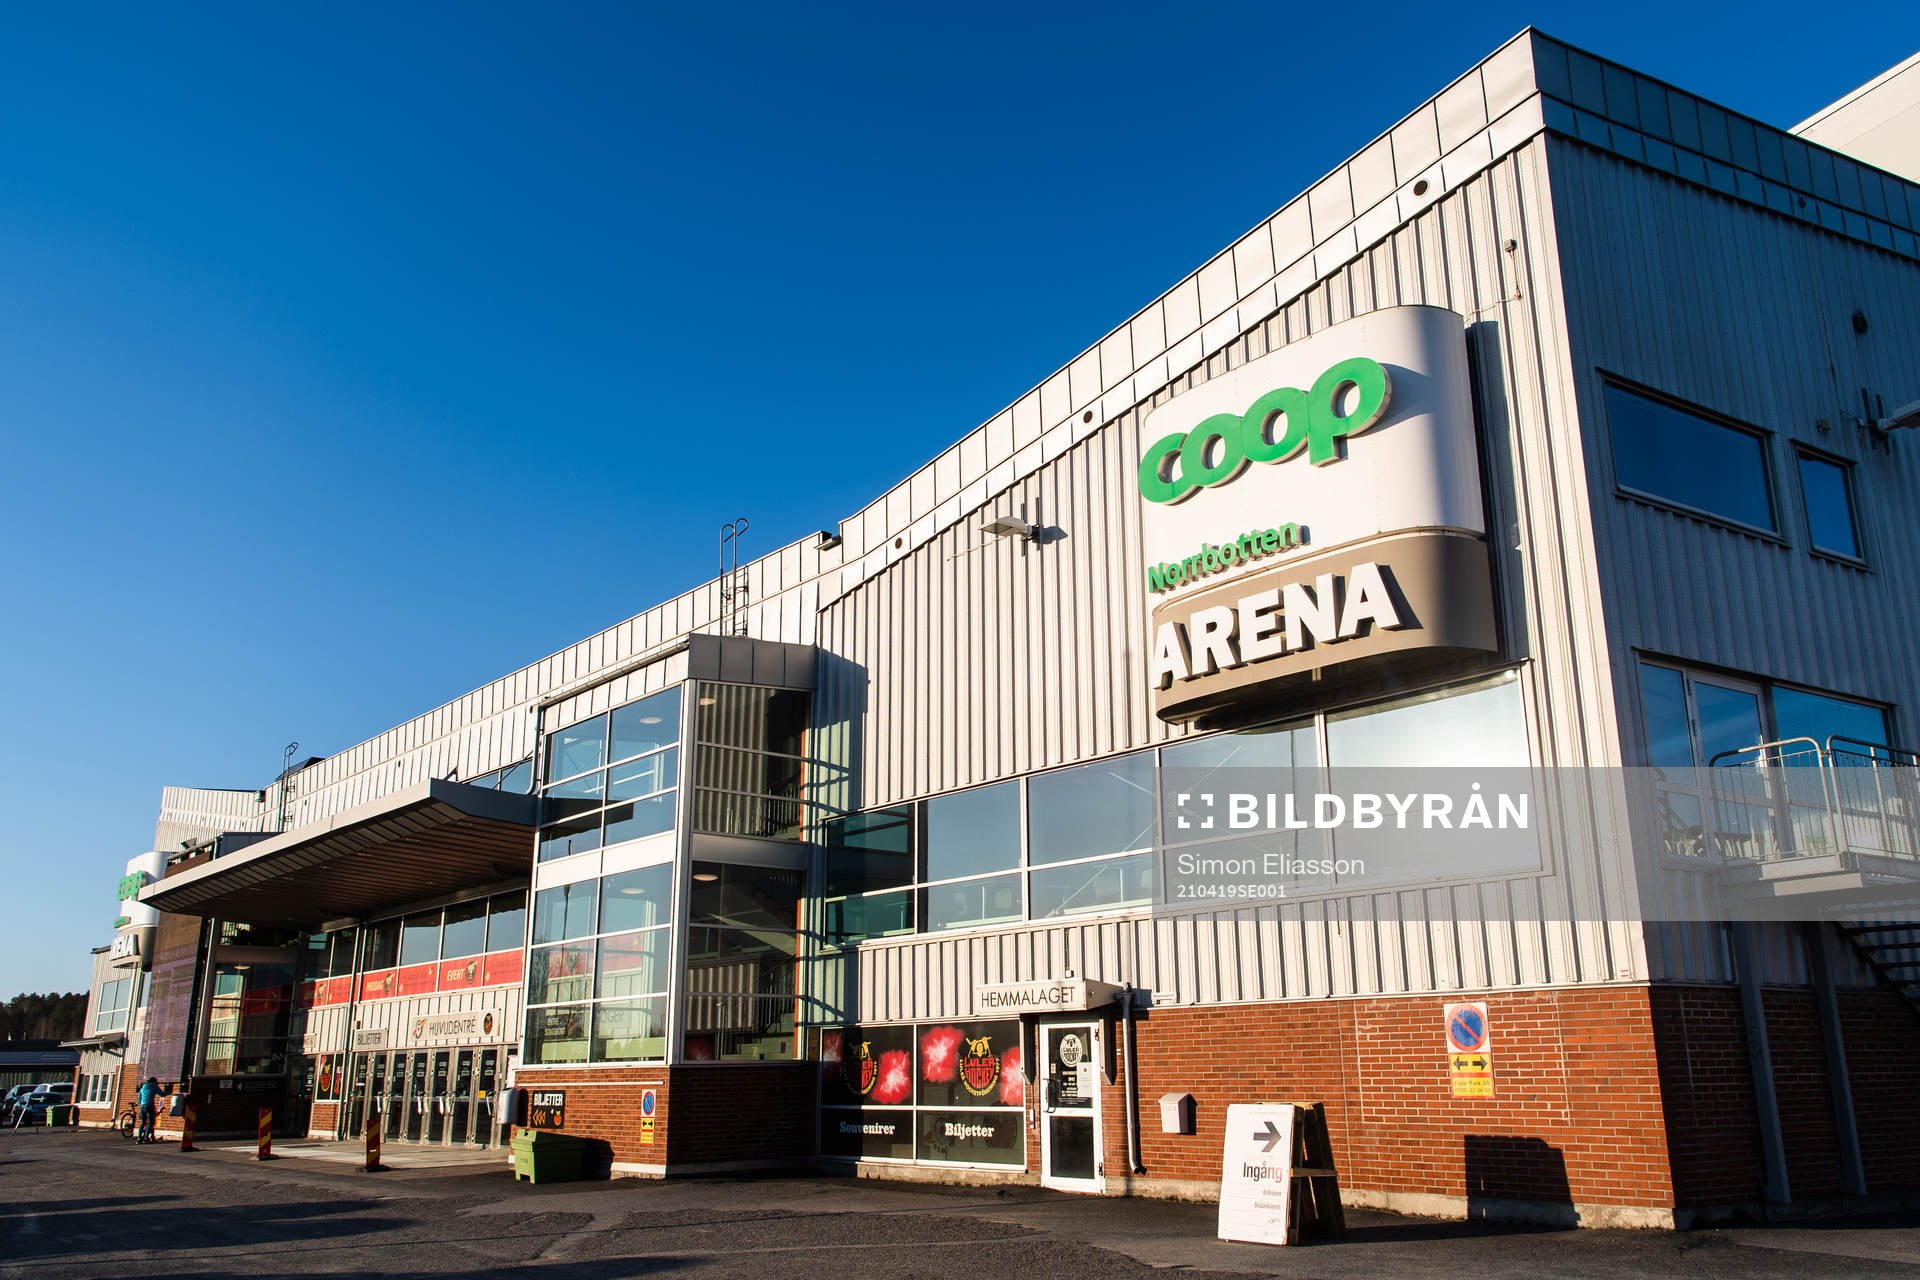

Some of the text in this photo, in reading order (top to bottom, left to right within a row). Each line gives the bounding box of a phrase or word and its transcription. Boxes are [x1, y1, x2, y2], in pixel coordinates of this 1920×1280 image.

[1138, 357, 1392, 505] coop
[1147, 521, 1299, 593] Norrbotten
[1152, 562, 1402, 689] ARENA
[446, 967, 466, 982] EVENT
[981, 986, 1076, 1008] HEMMALAGET
[429, 1016, 477, 1036] HUVUDENTRÉ
[356, 1032, 382, 1046] BILJETTER
[533, 1093, 563, 1106] BILJETTER
[840, 1120, 896, 1136] Souvenirer
[944, 1122, 995, 1140] Biljetter
[1243, 1161, 1282, 1183] Ingång
